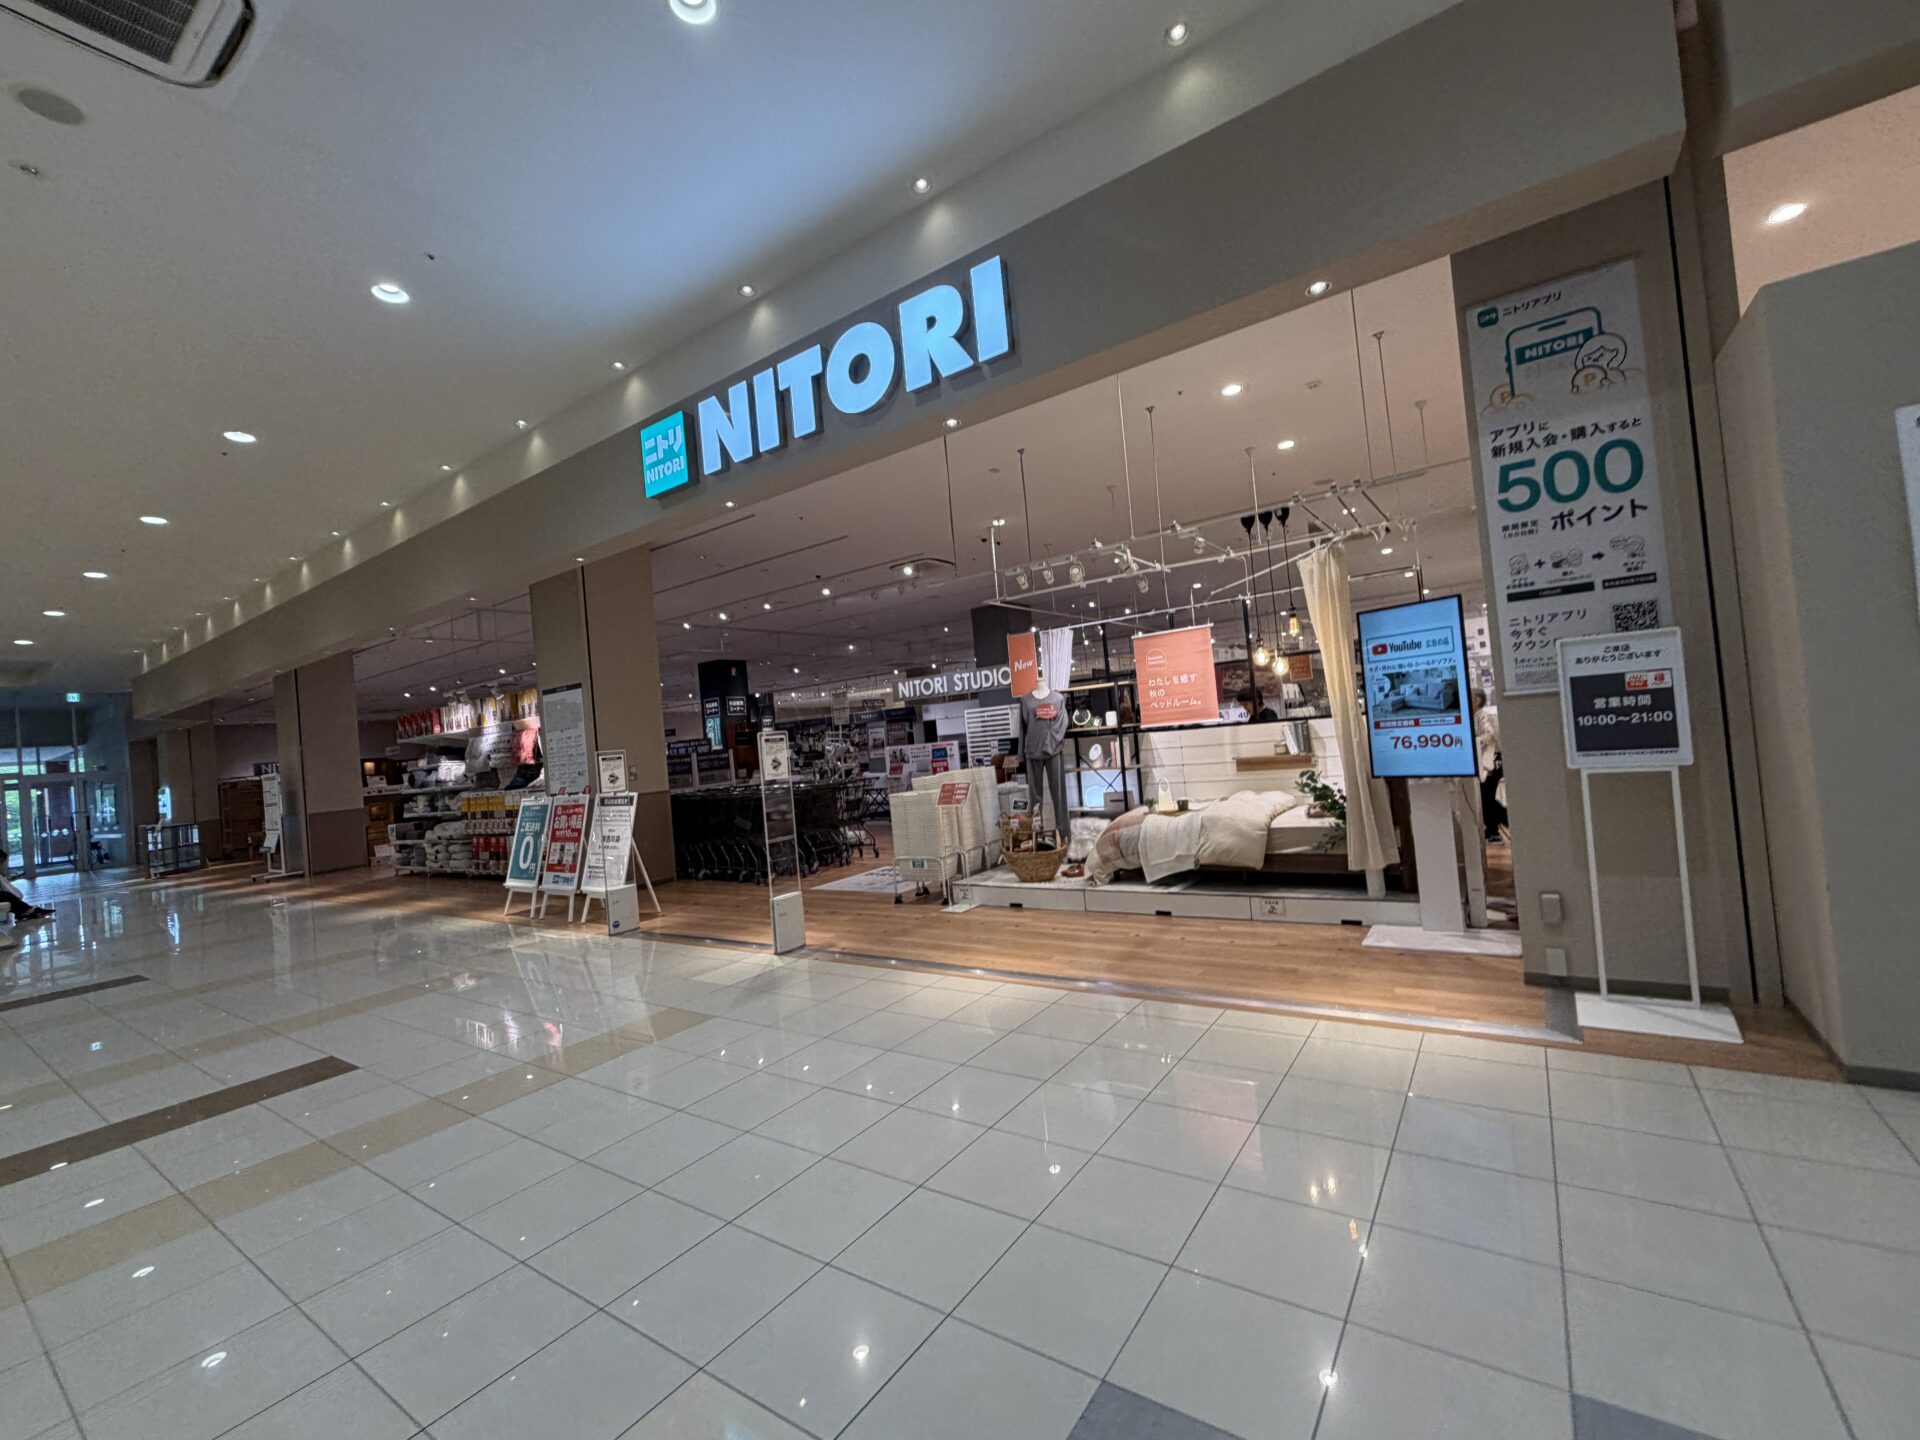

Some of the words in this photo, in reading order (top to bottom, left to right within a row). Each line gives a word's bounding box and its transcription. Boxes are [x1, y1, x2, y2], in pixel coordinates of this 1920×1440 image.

[1502, 291, 1562, 316] ニトリアプリ
[1524, 334, 1585, 359] NITORI
[698, 255, 1010, 475] NITORI
[1489, 421, 1550, 443] アプリに
[645, 425, 682, 464] ニトリ
[646, 455, 685, 484] NITORI
[1497, 438, 1644, 513] 500
[1551, 498, 1648, 531] ポイント
[1509, 609, 1587, 627] ニトリアプリ
[1510, 626, 1548, 639] 今すぐ
[1388, 639, 1422, 653] YouTube
[1575, 650, 1661, 664] ありがとうございます
[1014, 659, 1034, 673] New
[898, 675, 948, 699] NITORI
[953, 666, 1012, 692] STUDIO
[1148, 673, 1197, 687] わたしを癒す
[1593, 694, 1652, 709] 営業時間
